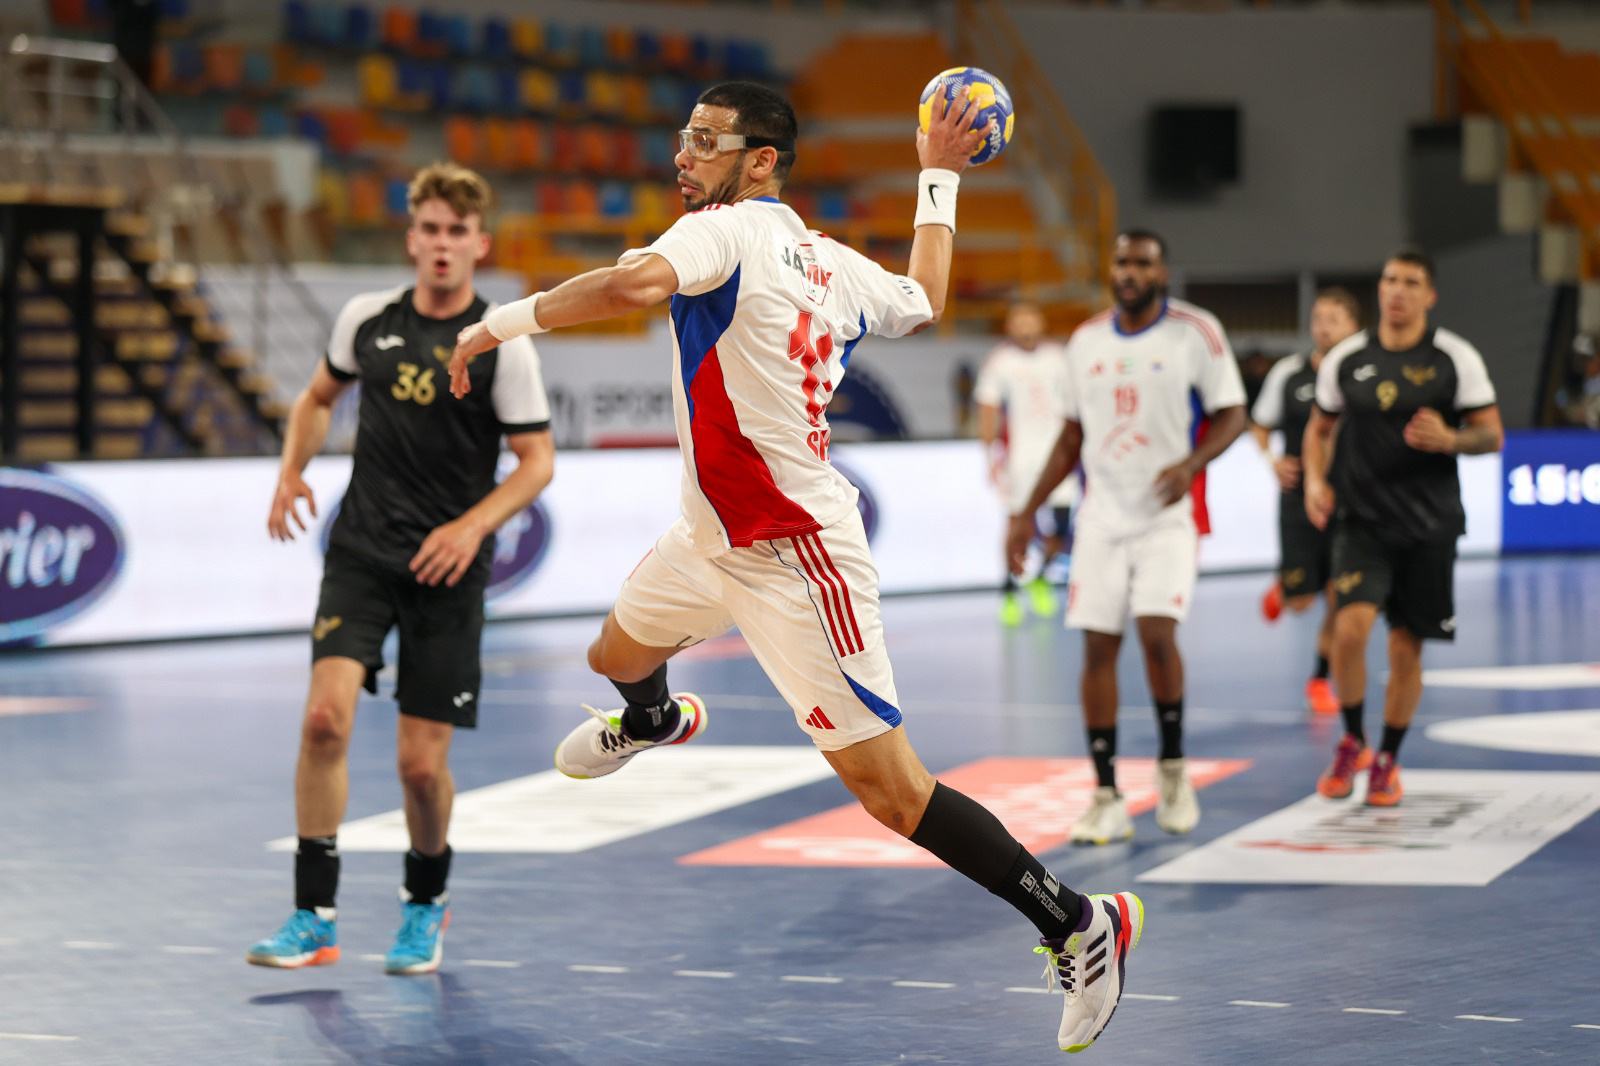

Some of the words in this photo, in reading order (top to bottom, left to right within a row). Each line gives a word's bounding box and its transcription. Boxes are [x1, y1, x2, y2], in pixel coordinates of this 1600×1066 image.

[391, 361, 436, 406] 36
[1376, 380, 1398, 411] 9
[1032, 883, 1069, 923] TAPEDESIGN
